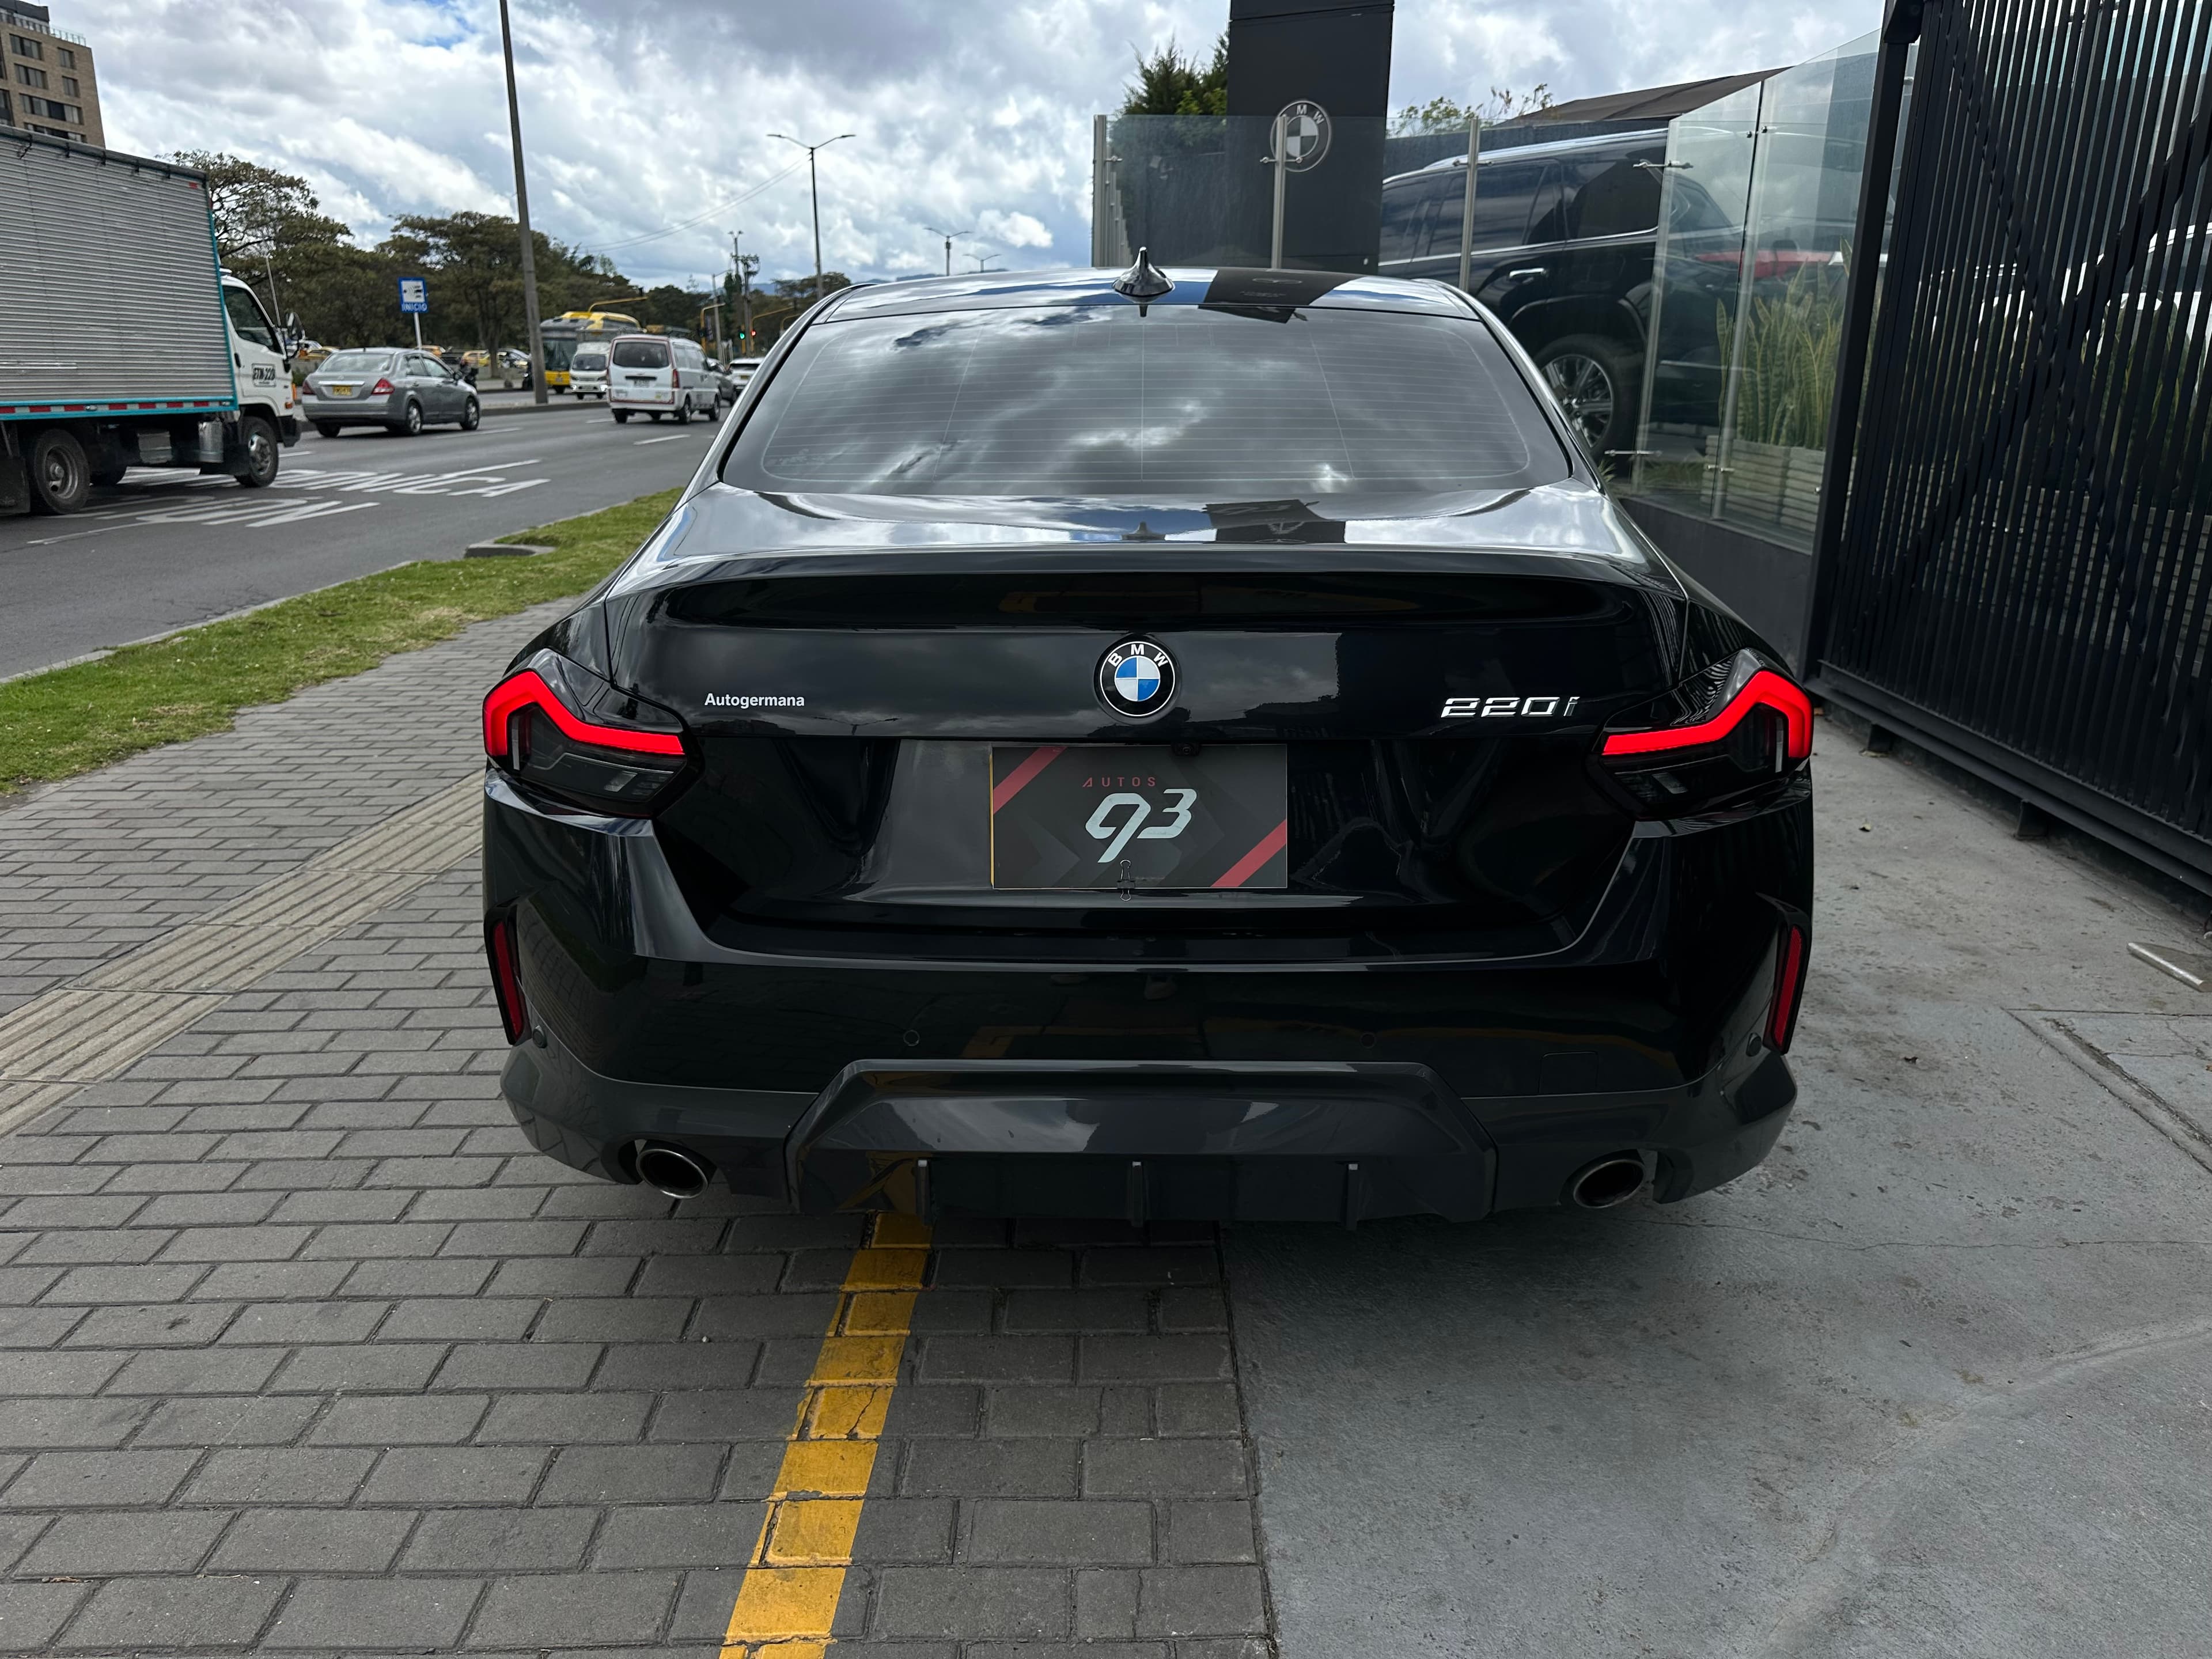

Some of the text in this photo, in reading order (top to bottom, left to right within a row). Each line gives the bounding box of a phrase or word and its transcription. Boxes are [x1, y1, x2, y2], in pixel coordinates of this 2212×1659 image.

[1107, 643, 1169, 668] BMW
[704, 692, 805, 709] Autogermana
[1440, 696, 1581, 718] 220i
[1082, 777, 1156, 787] AUTOS
[1085, 788, 1198, 863] 93
